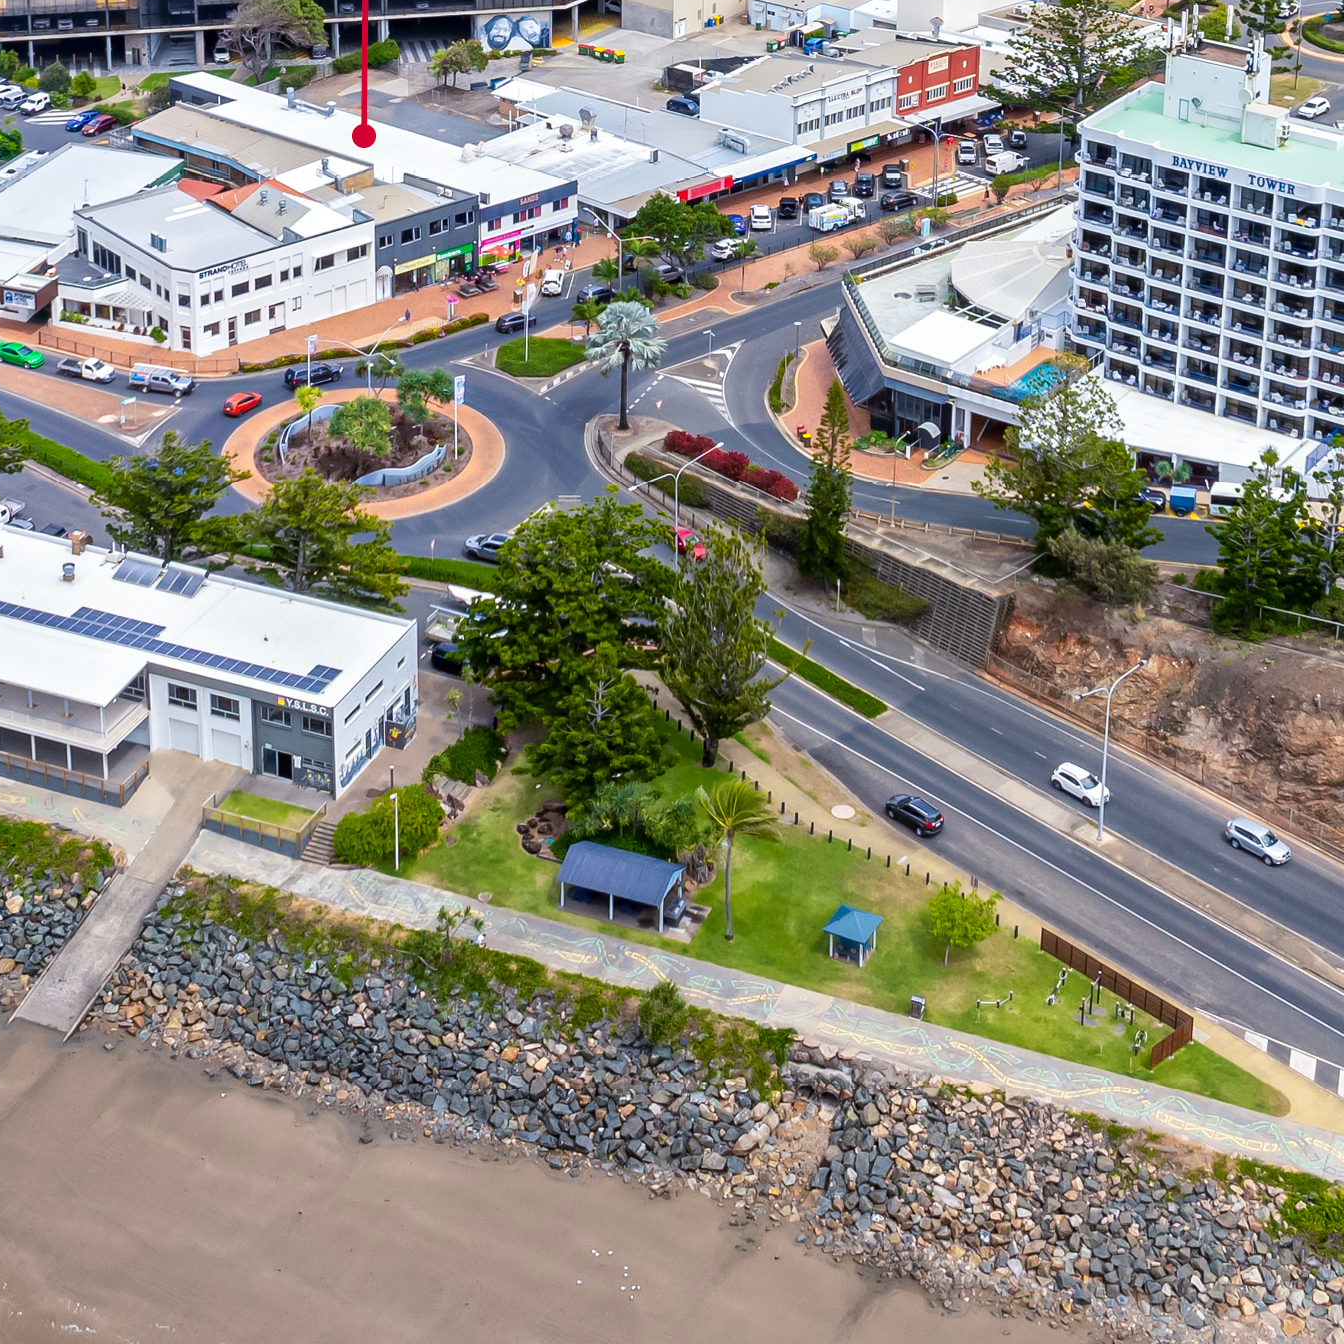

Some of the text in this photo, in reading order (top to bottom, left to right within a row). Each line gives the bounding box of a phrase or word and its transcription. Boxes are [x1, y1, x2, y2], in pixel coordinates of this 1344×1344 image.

[1172, 155, 1296, 195] BAYVIEW TOWER
[519, 193, 540, 206] SANDS
[285, 697, 330, 717] Y.S.L.S.C.
